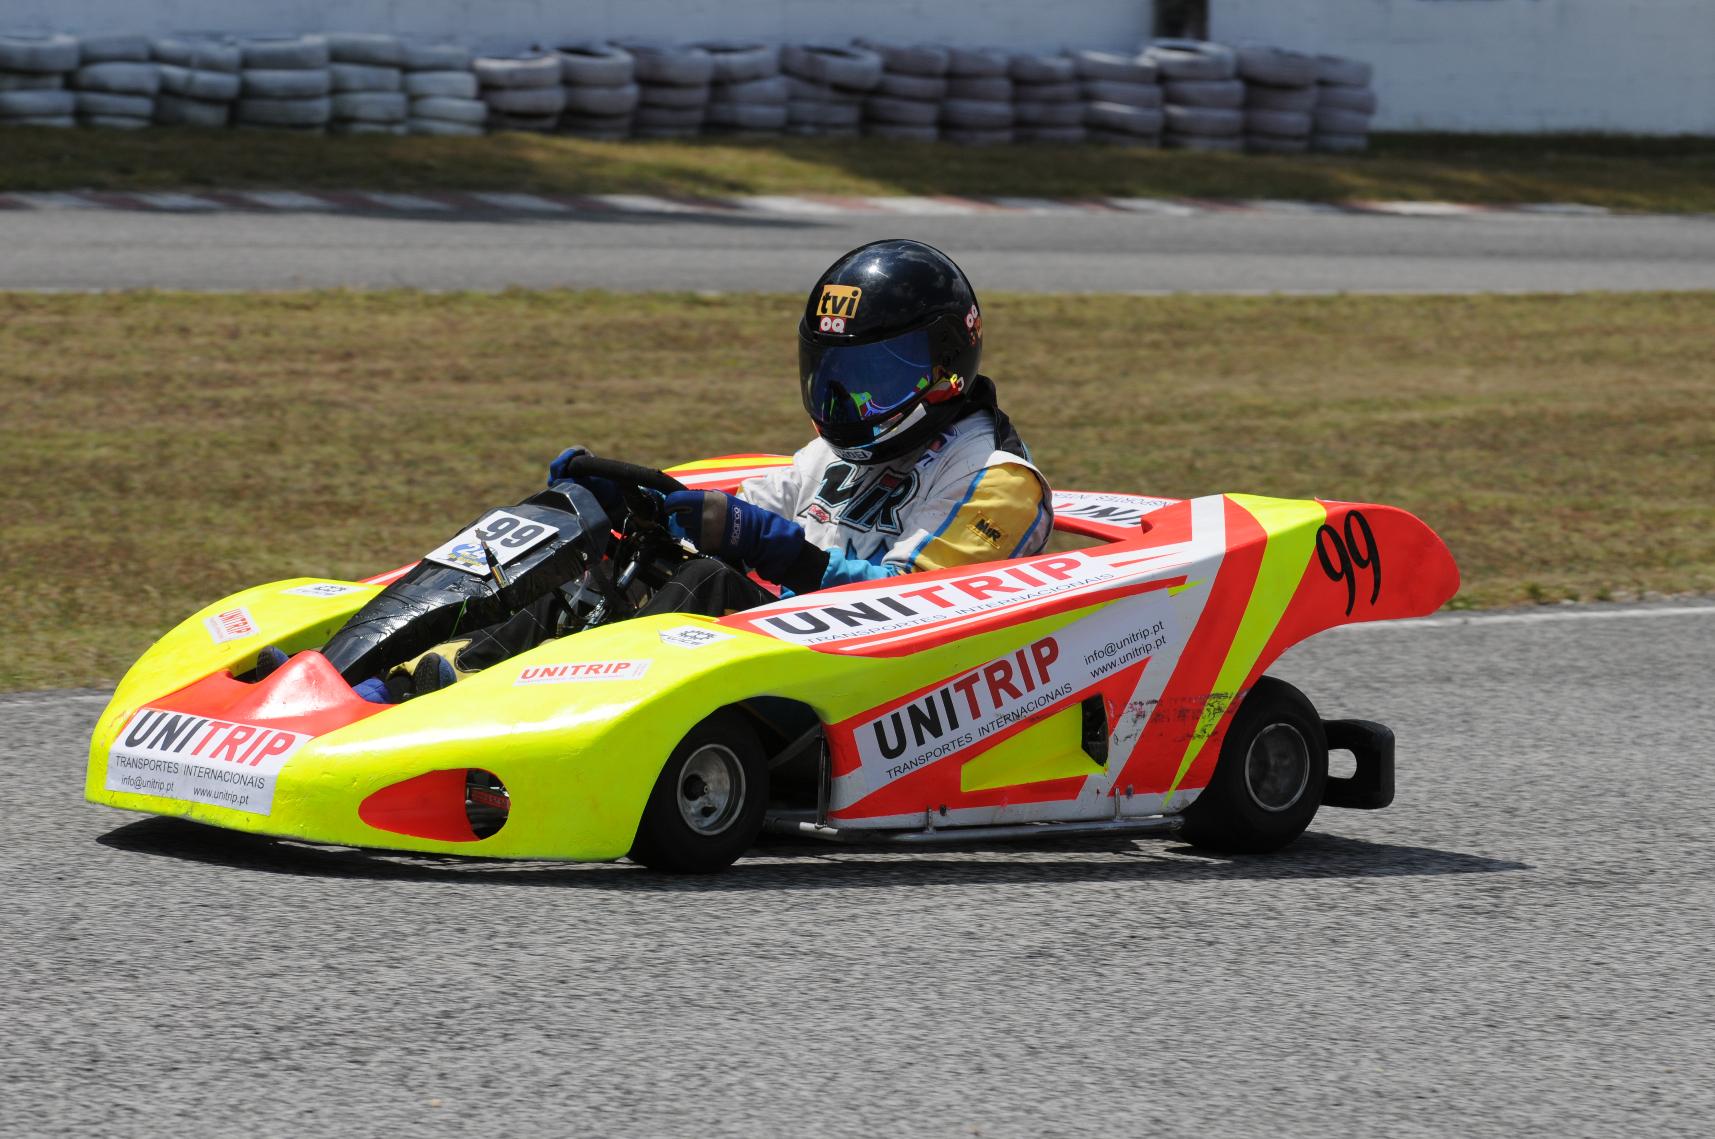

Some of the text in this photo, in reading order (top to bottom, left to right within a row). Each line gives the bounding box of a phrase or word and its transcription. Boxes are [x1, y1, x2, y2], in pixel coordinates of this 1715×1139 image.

[820, 290, 859, 316] tvi
[476, 517, 545, 549] 99
[1315, 509, 1382, 617] 99
[765, 557, 1082, 635] UNITRIP
[803, 573, 1115, 645] TRANSPORTES INTERNACIONAIS
[1084, 620, 1165, 666] info@unitrip.pt
[1090, 635, 1167, 679] www.unitrip.pt
[521, 662, 631, 680] UNITRIP
[873, 636, 1060, 760] UNITRIP
[124, 710, 297, 767] UNITRIP
[886, 682, 1073, 780] TRANSPORTES INTERNACIONAIS
[115, 755, 266, 790] TRANSPORTES INTERNACIONAIS
[121, 774, 250, 806] info@unitrip.pt www.unitrip.pt
